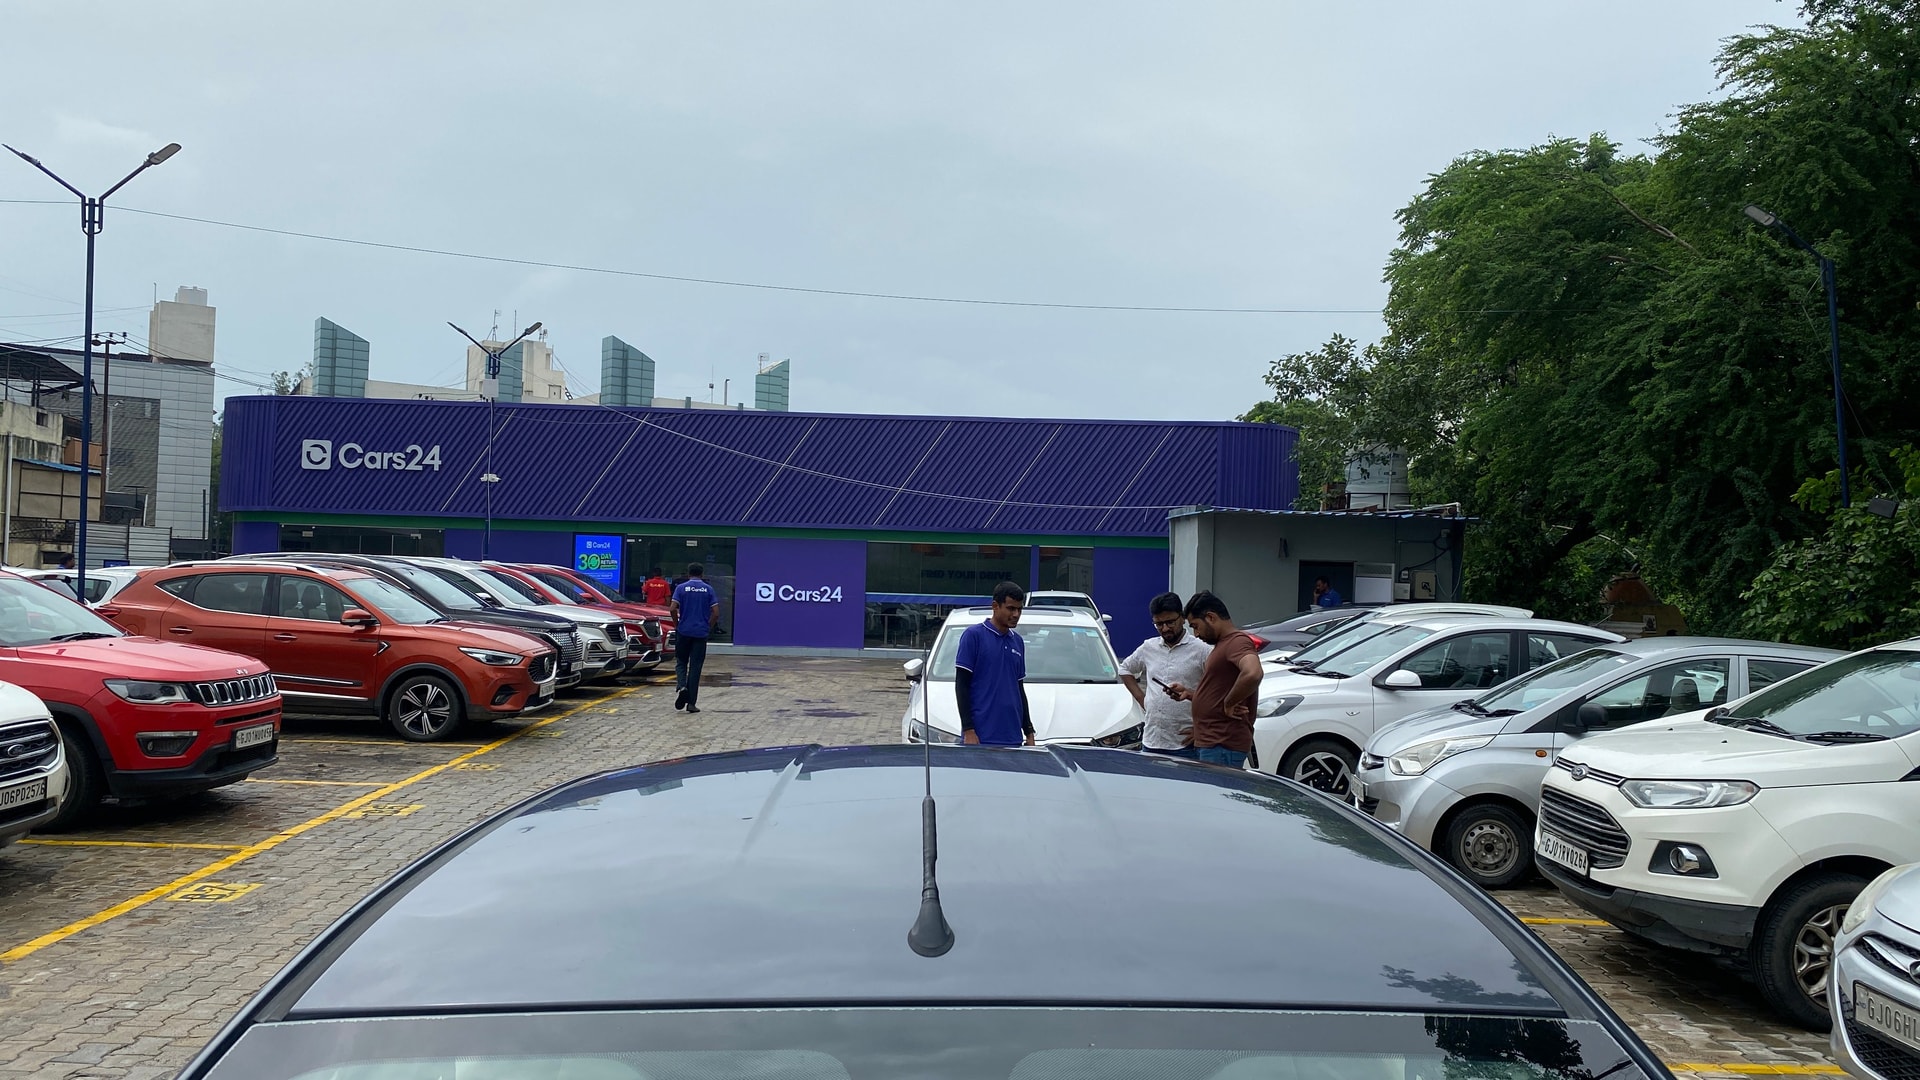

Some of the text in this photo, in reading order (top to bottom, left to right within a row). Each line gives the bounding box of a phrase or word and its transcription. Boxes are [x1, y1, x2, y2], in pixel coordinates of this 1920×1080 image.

[338, 442, 442, 471] Cars24
[948, 570, 976, 579] YOUR
[979, 571, 1012, 580] DRIVE
[778, 584, 843, 603] Cars24
